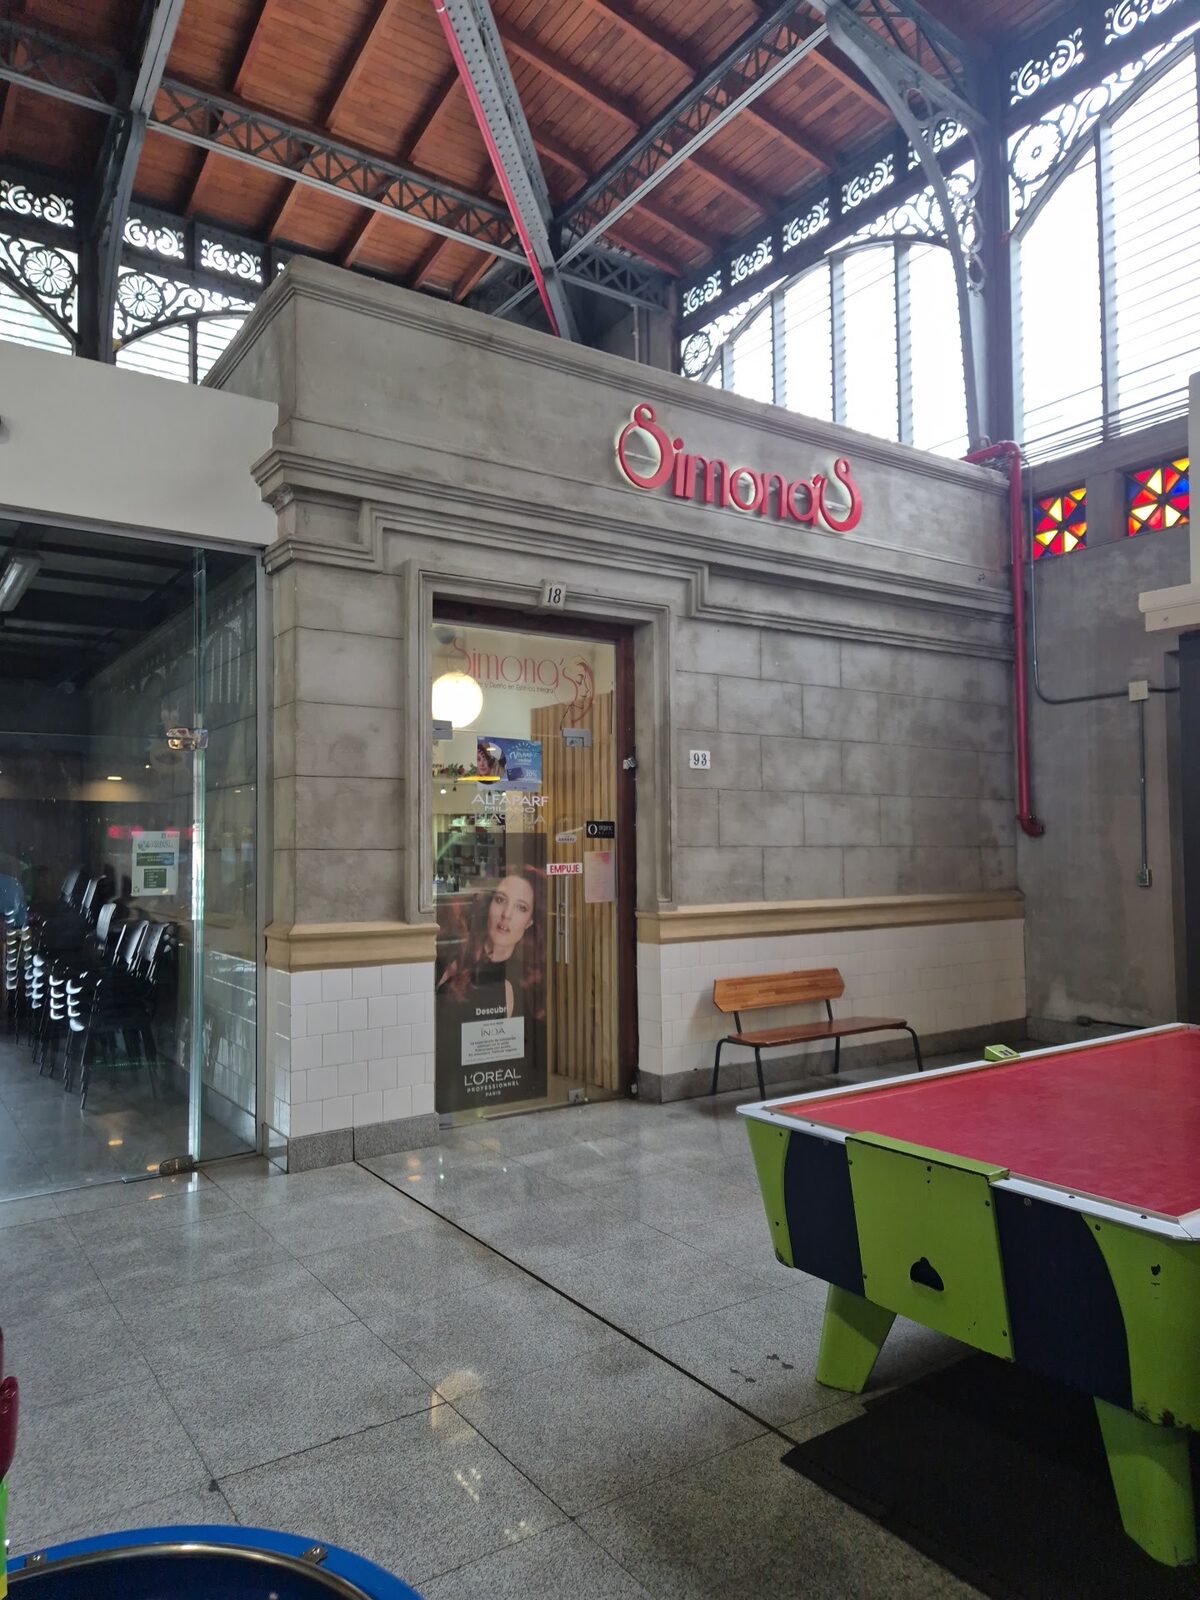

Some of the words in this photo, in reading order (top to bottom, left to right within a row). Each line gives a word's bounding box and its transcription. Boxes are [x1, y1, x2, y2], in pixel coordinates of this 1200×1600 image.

[547, 586, 562, 604] 18
[693, 752, 707, 767] 93
[471, 793, 549, 807] ALFAPARF
[549, 864, 580, 874] EMPUJE
